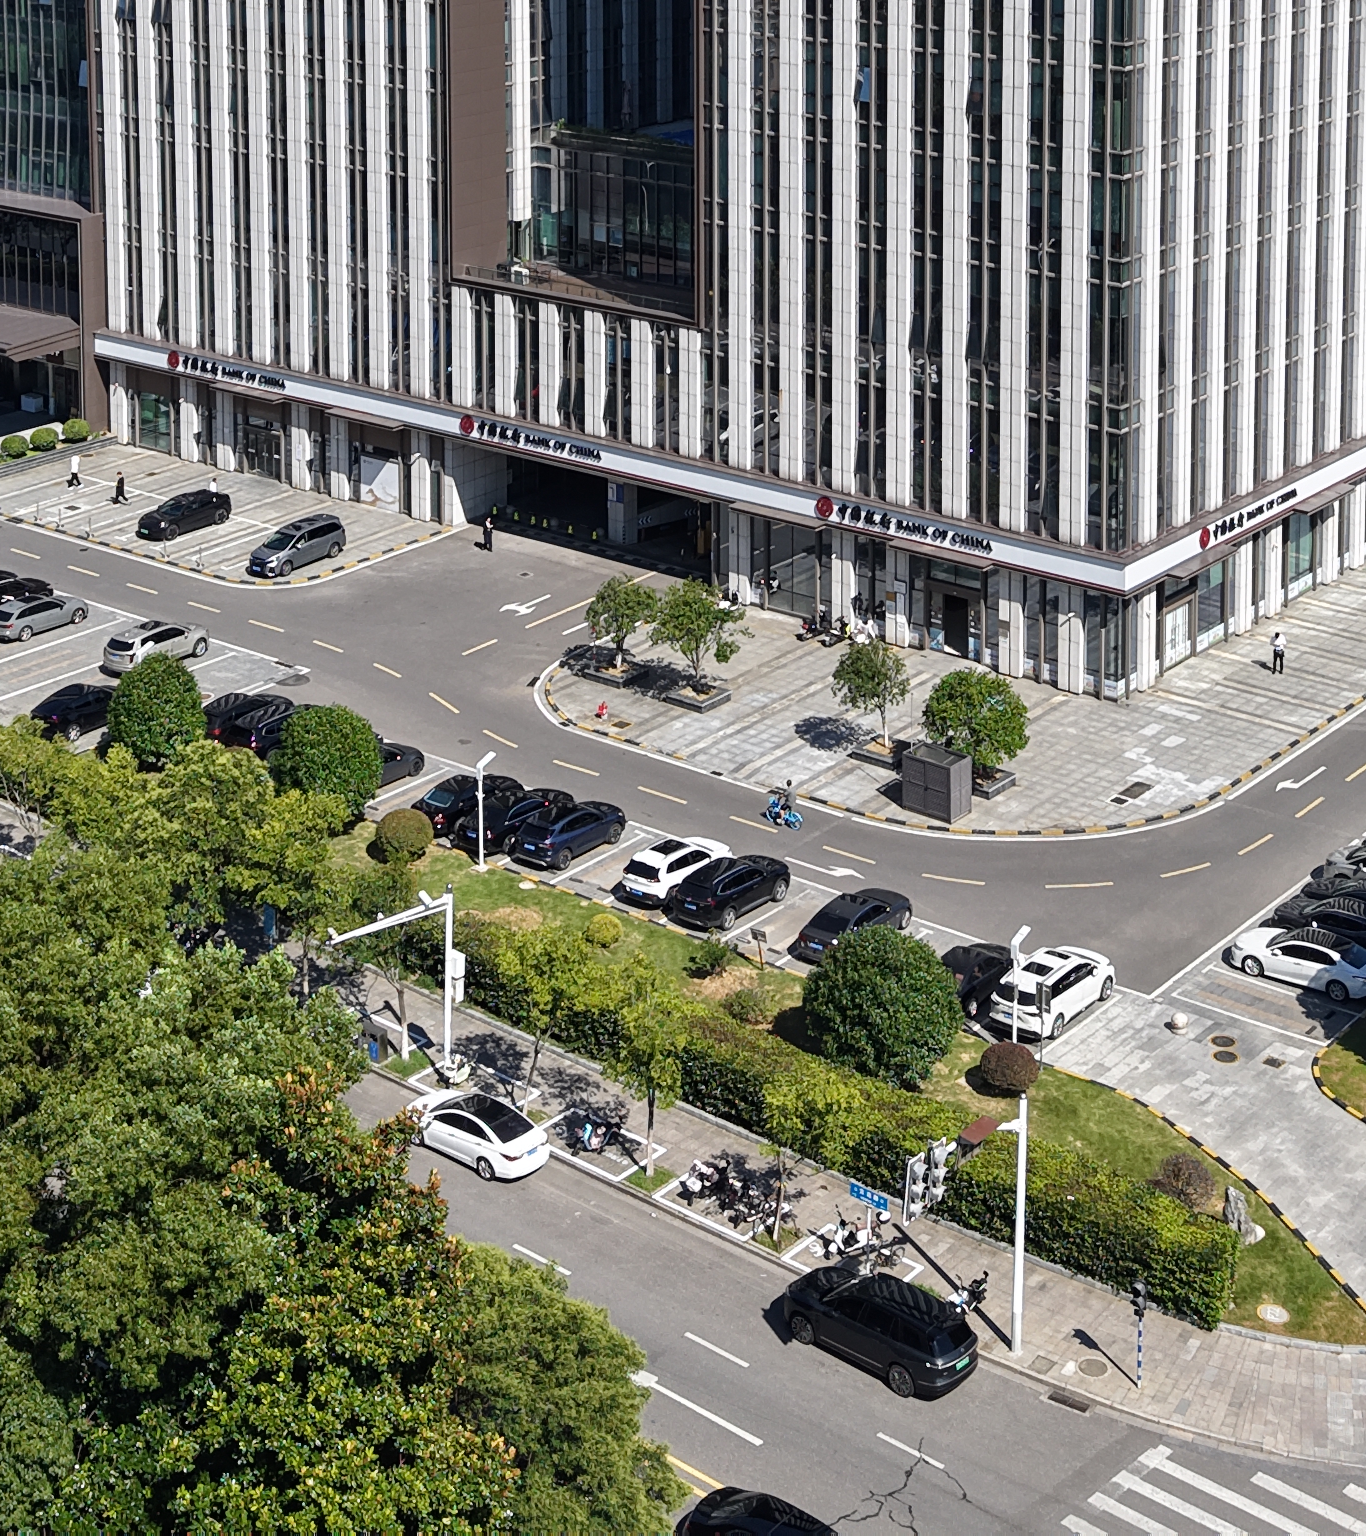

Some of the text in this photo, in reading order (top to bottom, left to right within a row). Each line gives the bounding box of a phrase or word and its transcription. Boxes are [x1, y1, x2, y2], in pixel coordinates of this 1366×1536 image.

[523, 433, 602, 461] BANK OF CHINA
[896, 519, 993, 552] BANK OF CHINA
